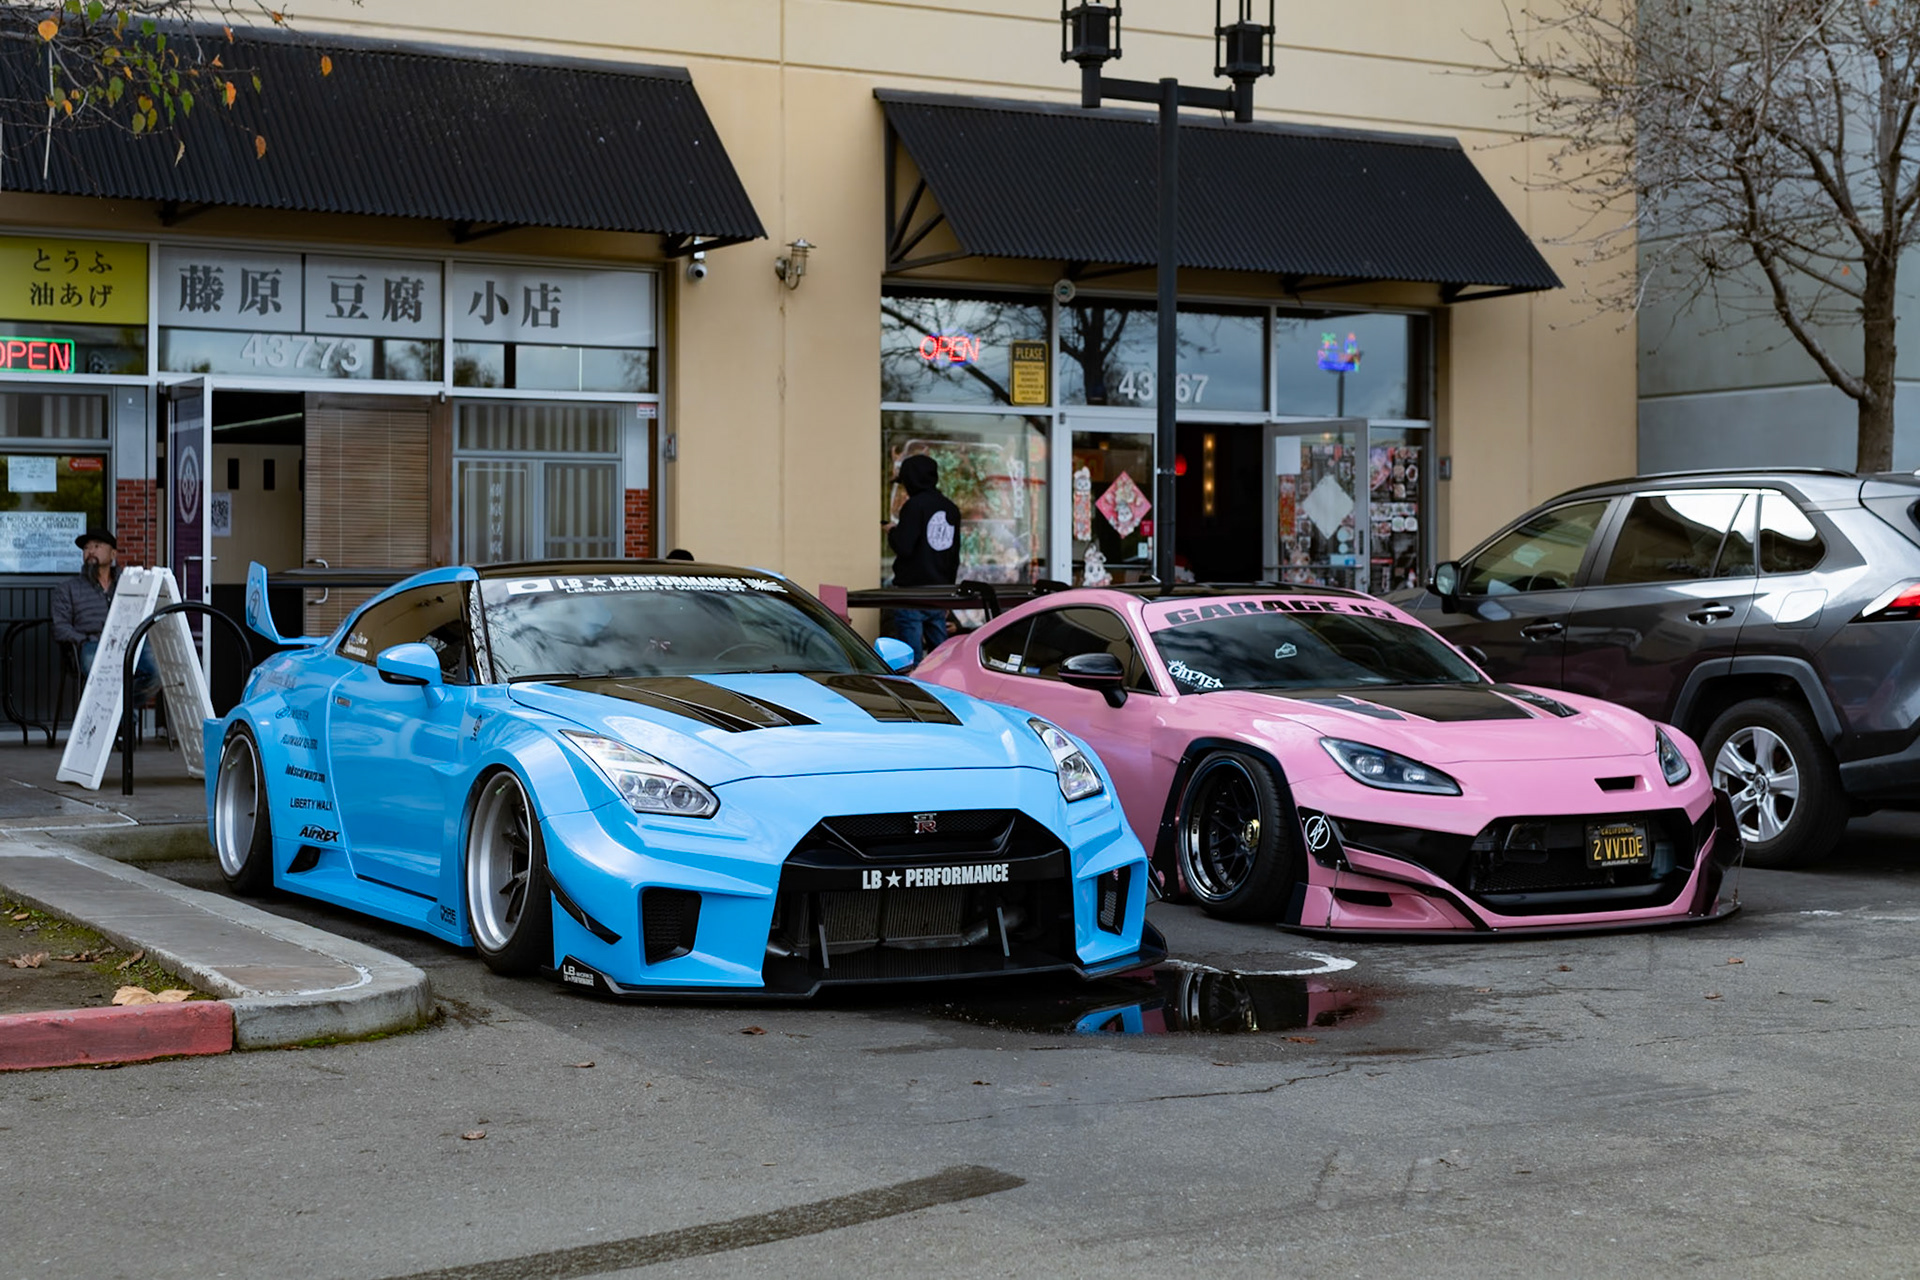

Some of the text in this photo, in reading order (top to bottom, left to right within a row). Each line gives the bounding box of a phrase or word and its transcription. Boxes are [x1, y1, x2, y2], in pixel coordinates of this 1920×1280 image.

[33, 248, 113, 274] とうふ
[29, 282, 113, 309] 油あげ
[178, 264, 562, 328] 藤原 豆腐 小店
[240, 332, 363, 372] 43773
[919, 335, 980, 362] OPEN
[1015, 347, 1044, 360] PLEASE
[1118, 371, 1209, 403] 4367
[556, 575, 747, 590] LB PERFORMANCE
[1164, 601, 1346, 624] GARAGE
[290, 797, 333, 812] LIBERTY WALK
[862, 863, 1009, 890] LB PERFORMANCE
[563, 965, 575, 976] LB
